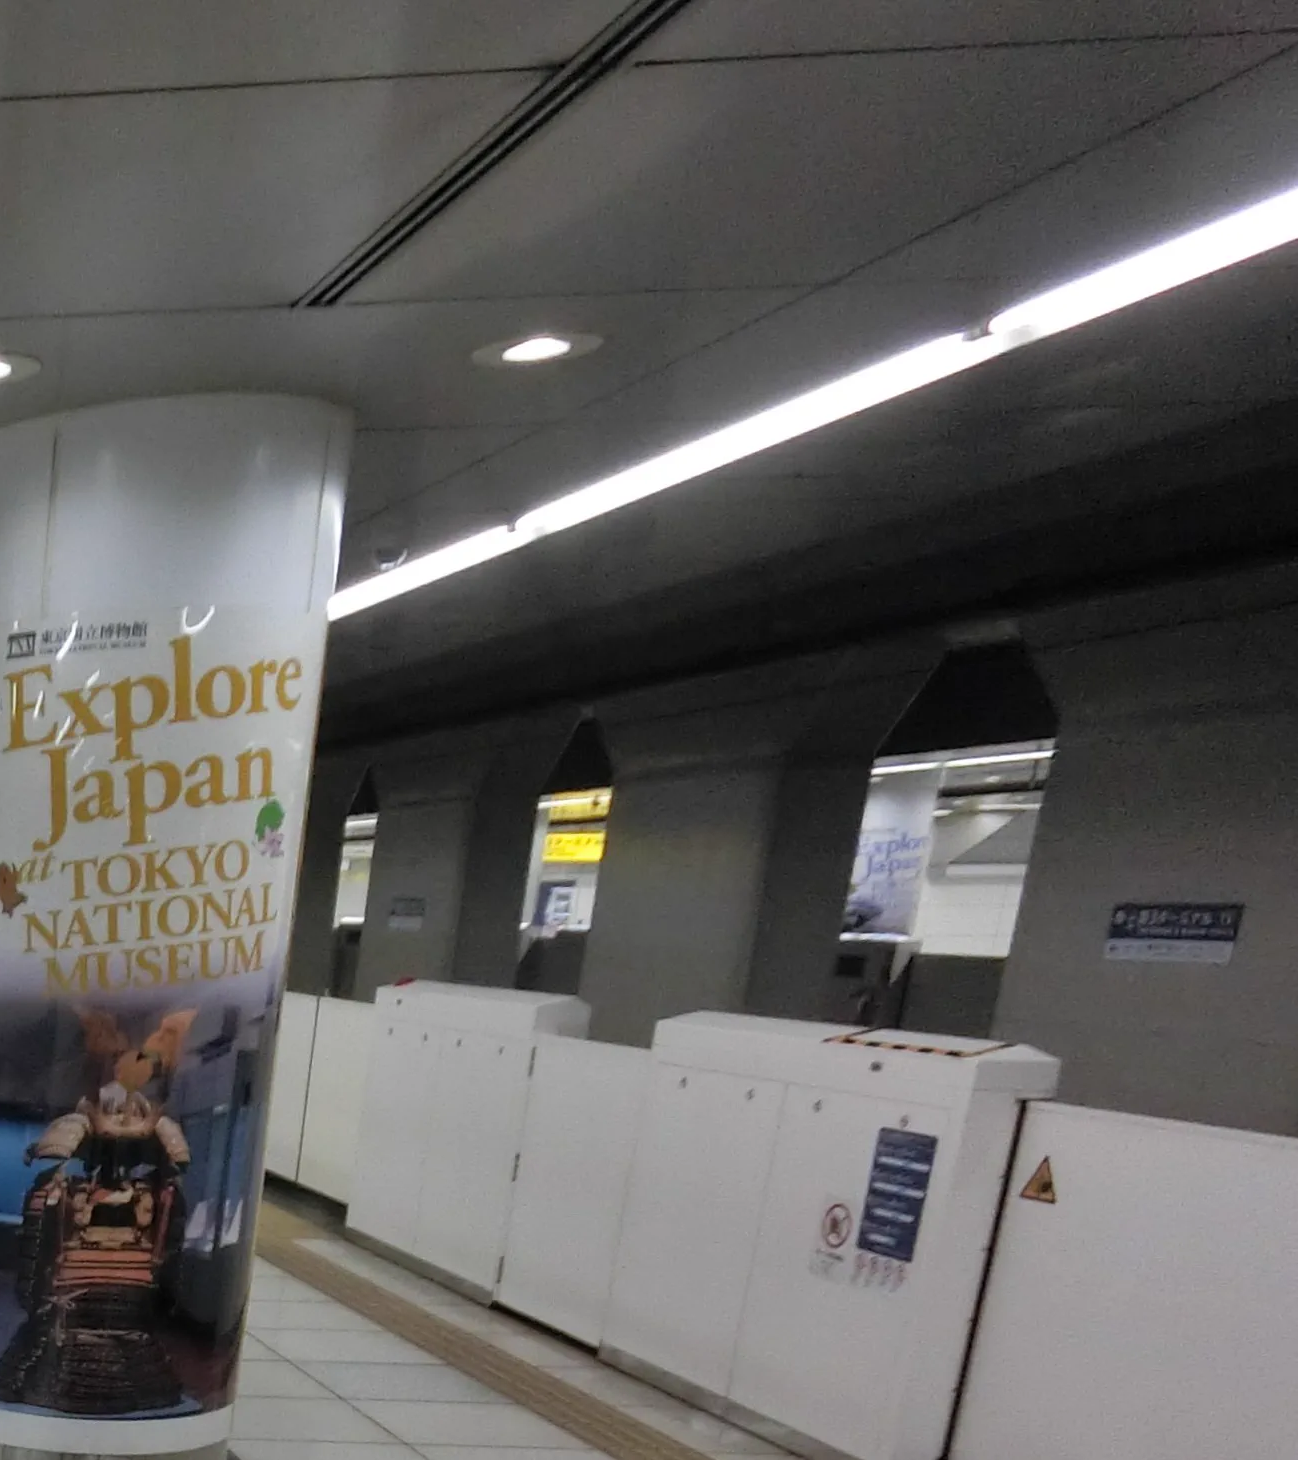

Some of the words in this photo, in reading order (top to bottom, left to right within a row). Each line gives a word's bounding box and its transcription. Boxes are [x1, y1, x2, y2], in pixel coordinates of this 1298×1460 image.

[3, 634, 303, 763] Explore
[32, 745, 274, 850] Japan
[16, 851, 56, 884] at
[61, 839, 251, 902] TOKYO
[21, 882, 278, 953] NATIONAL
[41, 930, 266, 997] MUSEUM
